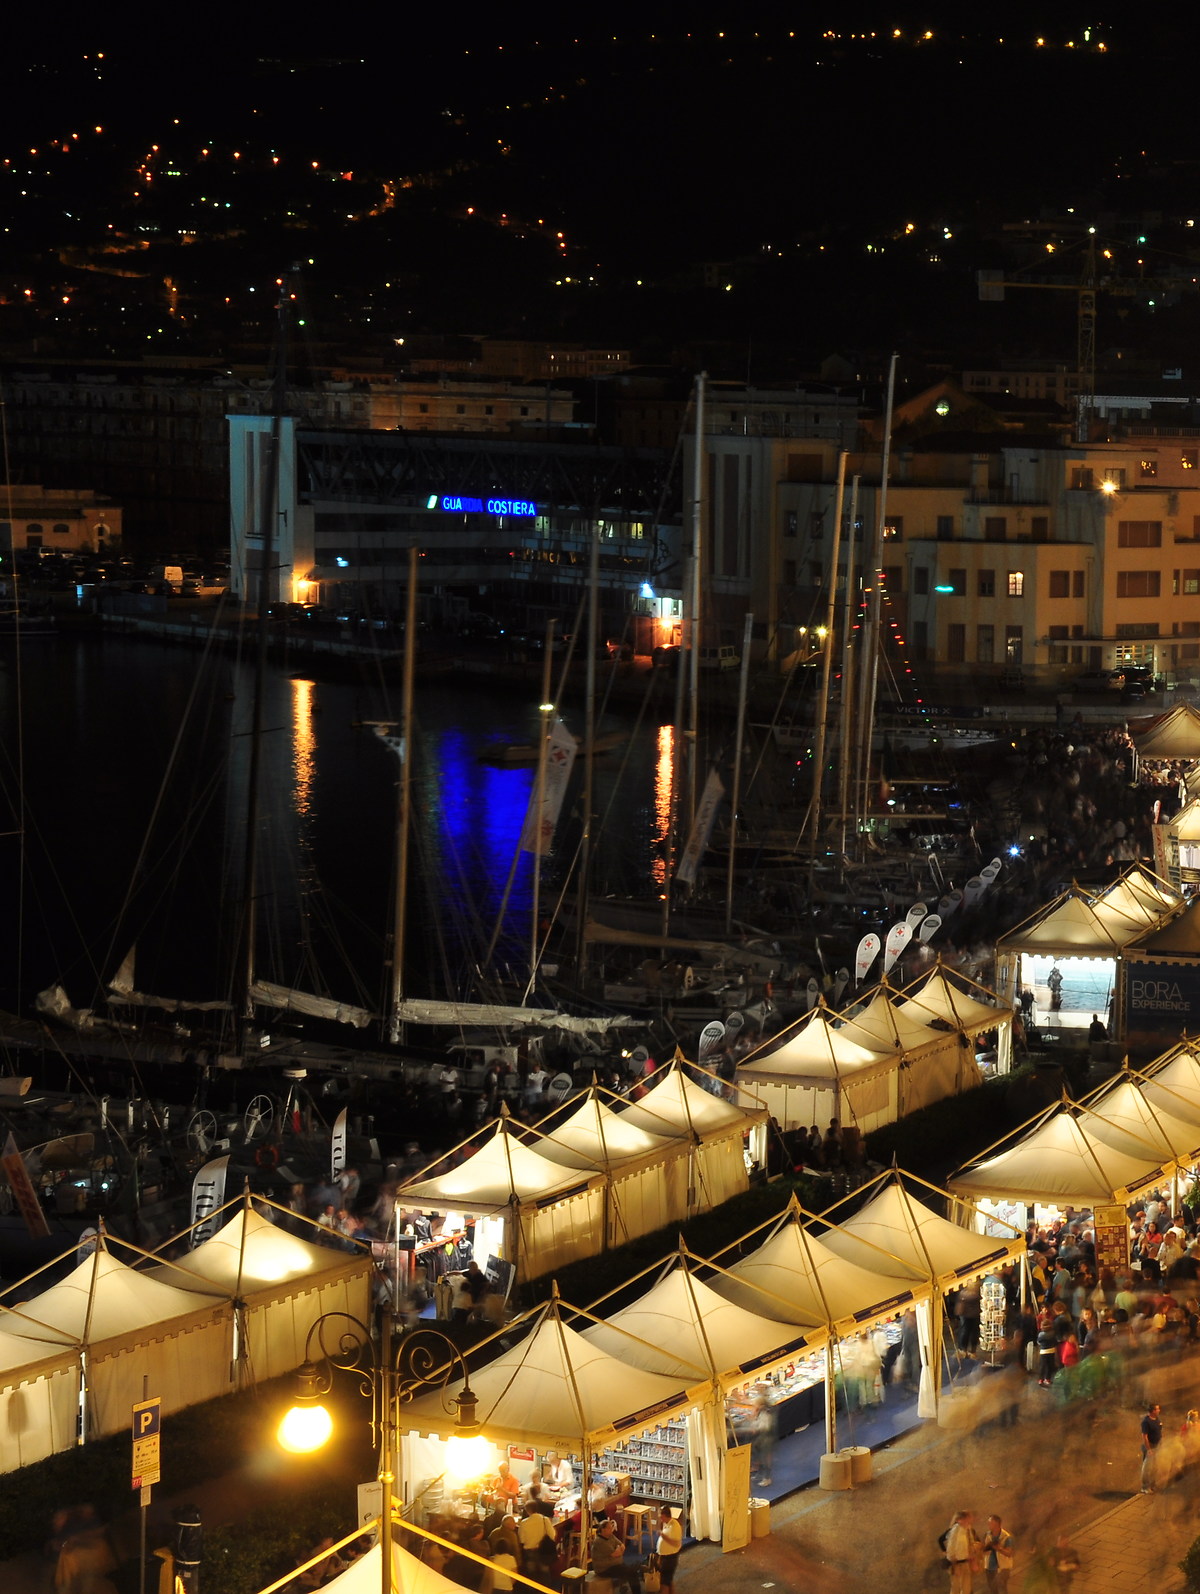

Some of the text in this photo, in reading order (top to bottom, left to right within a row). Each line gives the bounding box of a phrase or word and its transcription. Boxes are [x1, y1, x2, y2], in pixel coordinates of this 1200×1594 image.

[487, 499, 535, 516] COSTIERA
[1131, 980, 1183, 1001] BORA
[1131, 1000, 1191, 1012] EXPERIENCE
[140, 1411, 153, 1434] P
